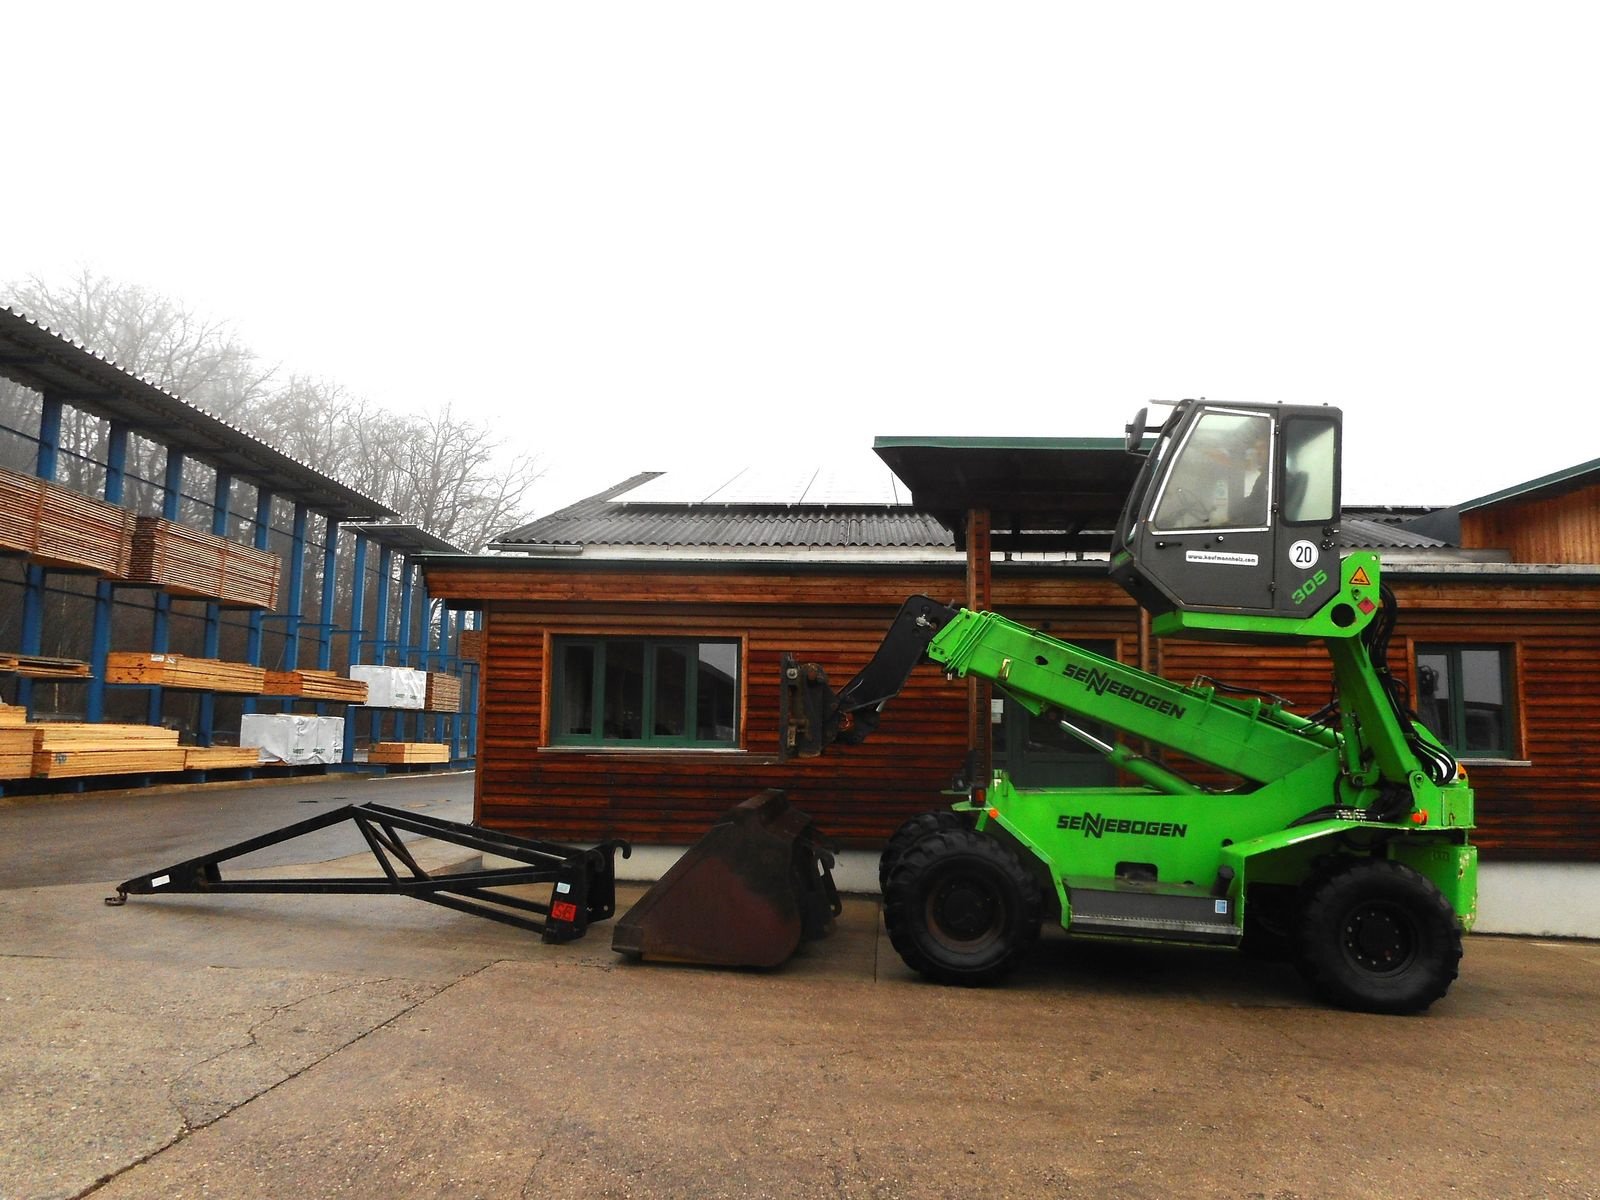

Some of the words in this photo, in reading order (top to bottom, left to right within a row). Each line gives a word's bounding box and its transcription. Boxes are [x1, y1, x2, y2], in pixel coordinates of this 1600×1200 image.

[1296, 546, 1312, 563] 20
[1291, 569, 1328, 605] 305
[1061, 663, 1187, 719] SENNEBOGEN
[1056, 812, 1188, 838] SENNEBOGEN
